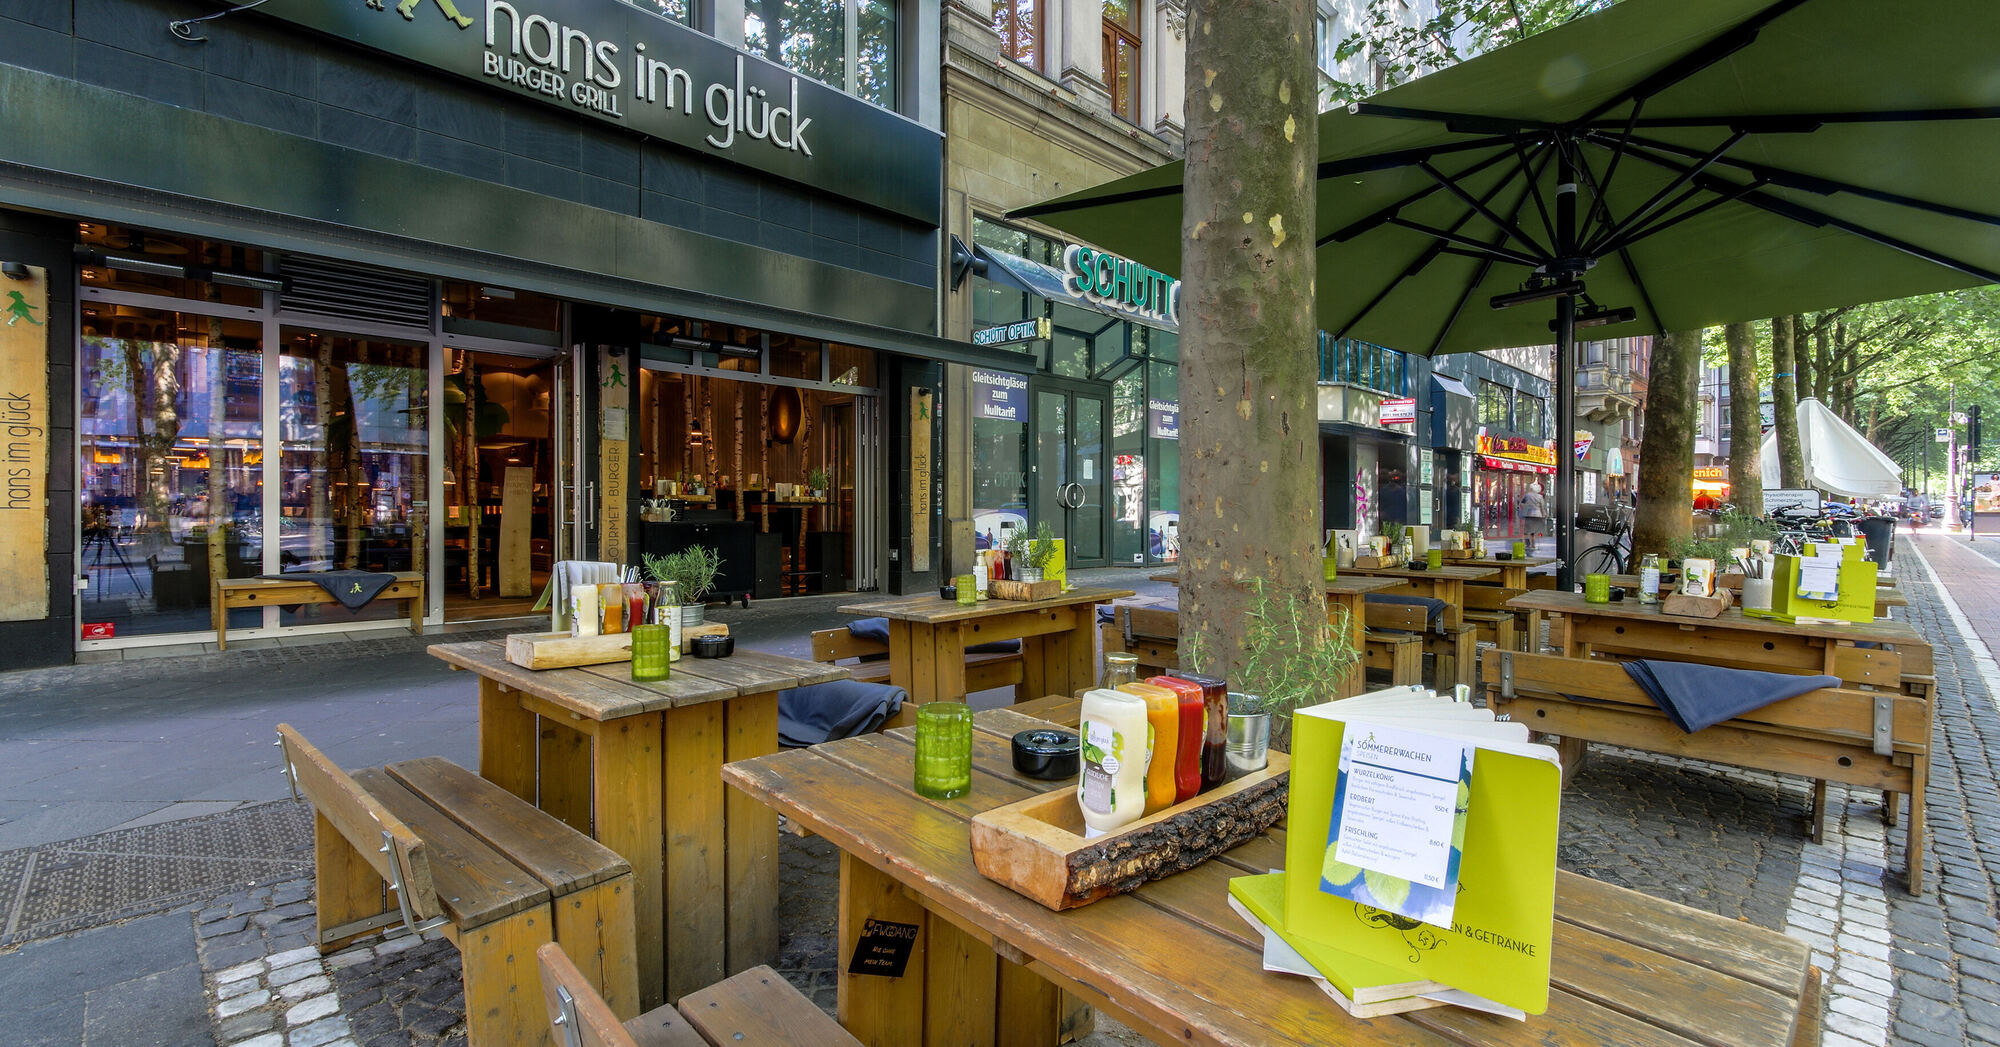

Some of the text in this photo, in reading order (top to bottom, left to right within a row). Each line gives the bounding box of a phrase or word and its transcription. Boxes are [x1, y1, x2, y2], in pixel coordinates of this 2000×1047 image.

[483, 51, 622, 118] BURGER GRILL
[485, 0, 813, 156] hans im glück
[1074, 246, 1177, 316] SCHÜTT
[973, 320, 1036, 345] SCHÜTT OPTIK
[972, 371, 1028, 389] Gleitsichtgläser
[991, 390, 1008, 399] zum
[984, 403, 1016, 418] Nulltarif!
[1149, 400, 1179, 414] Gleitsichtglä
[0, 392, 43, 510] hans im glück
[608, 447, 620, 497] BURGER
[914, 454, 930, 477] glück
[915, 492, 927, 515] hans
[1357, 740, 1432, 762] SOMMERERWACHEN
[1354, 768, 1394, 782] WURZELKÖNIG
[1344, 825, 1378, 840] FRISCHLING
[1474, 929, 1536, 957] GETRÄNKE
